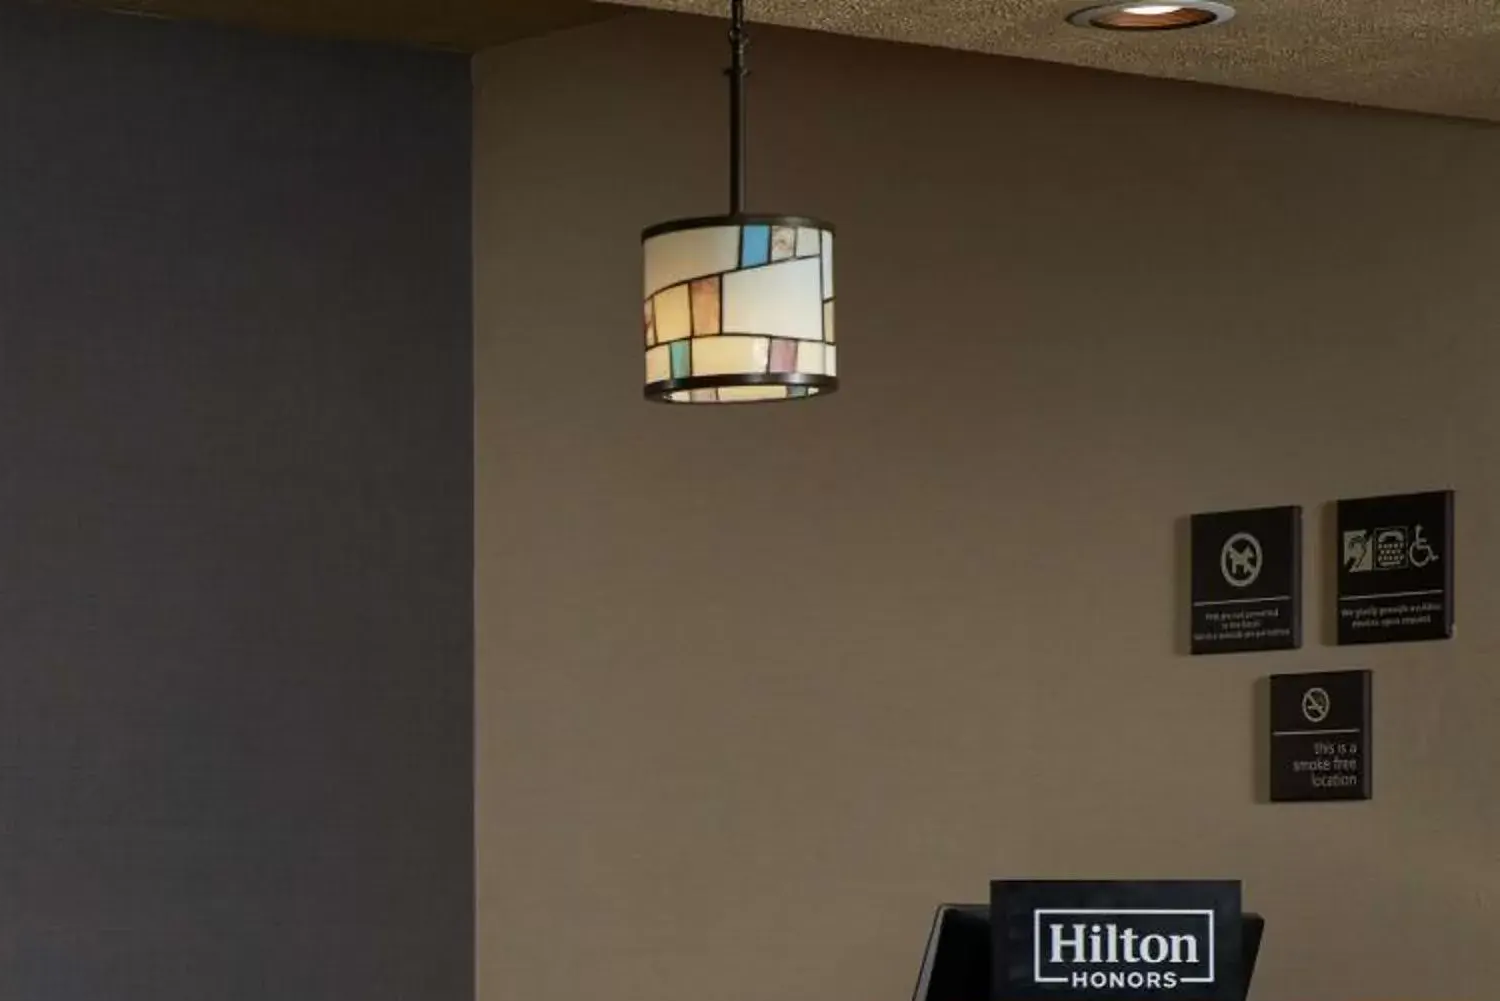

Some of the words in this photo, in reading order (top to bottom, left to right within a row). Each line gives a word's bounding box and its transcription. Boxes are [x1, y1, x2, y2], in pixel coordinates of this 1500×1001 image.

[1314, 742, 1334, 755] this
[1337, 742, 1347, 754] is
[1349, 743, 1357, 754] a
[1293, 758, 1330, 772] smoke
[1333, 756, 1357, 770] free
[1312, 771, 1357, 787] location
[1049, 923, 1200, 963] Hilton
[1072, 971, 1178, 989] HONORS
